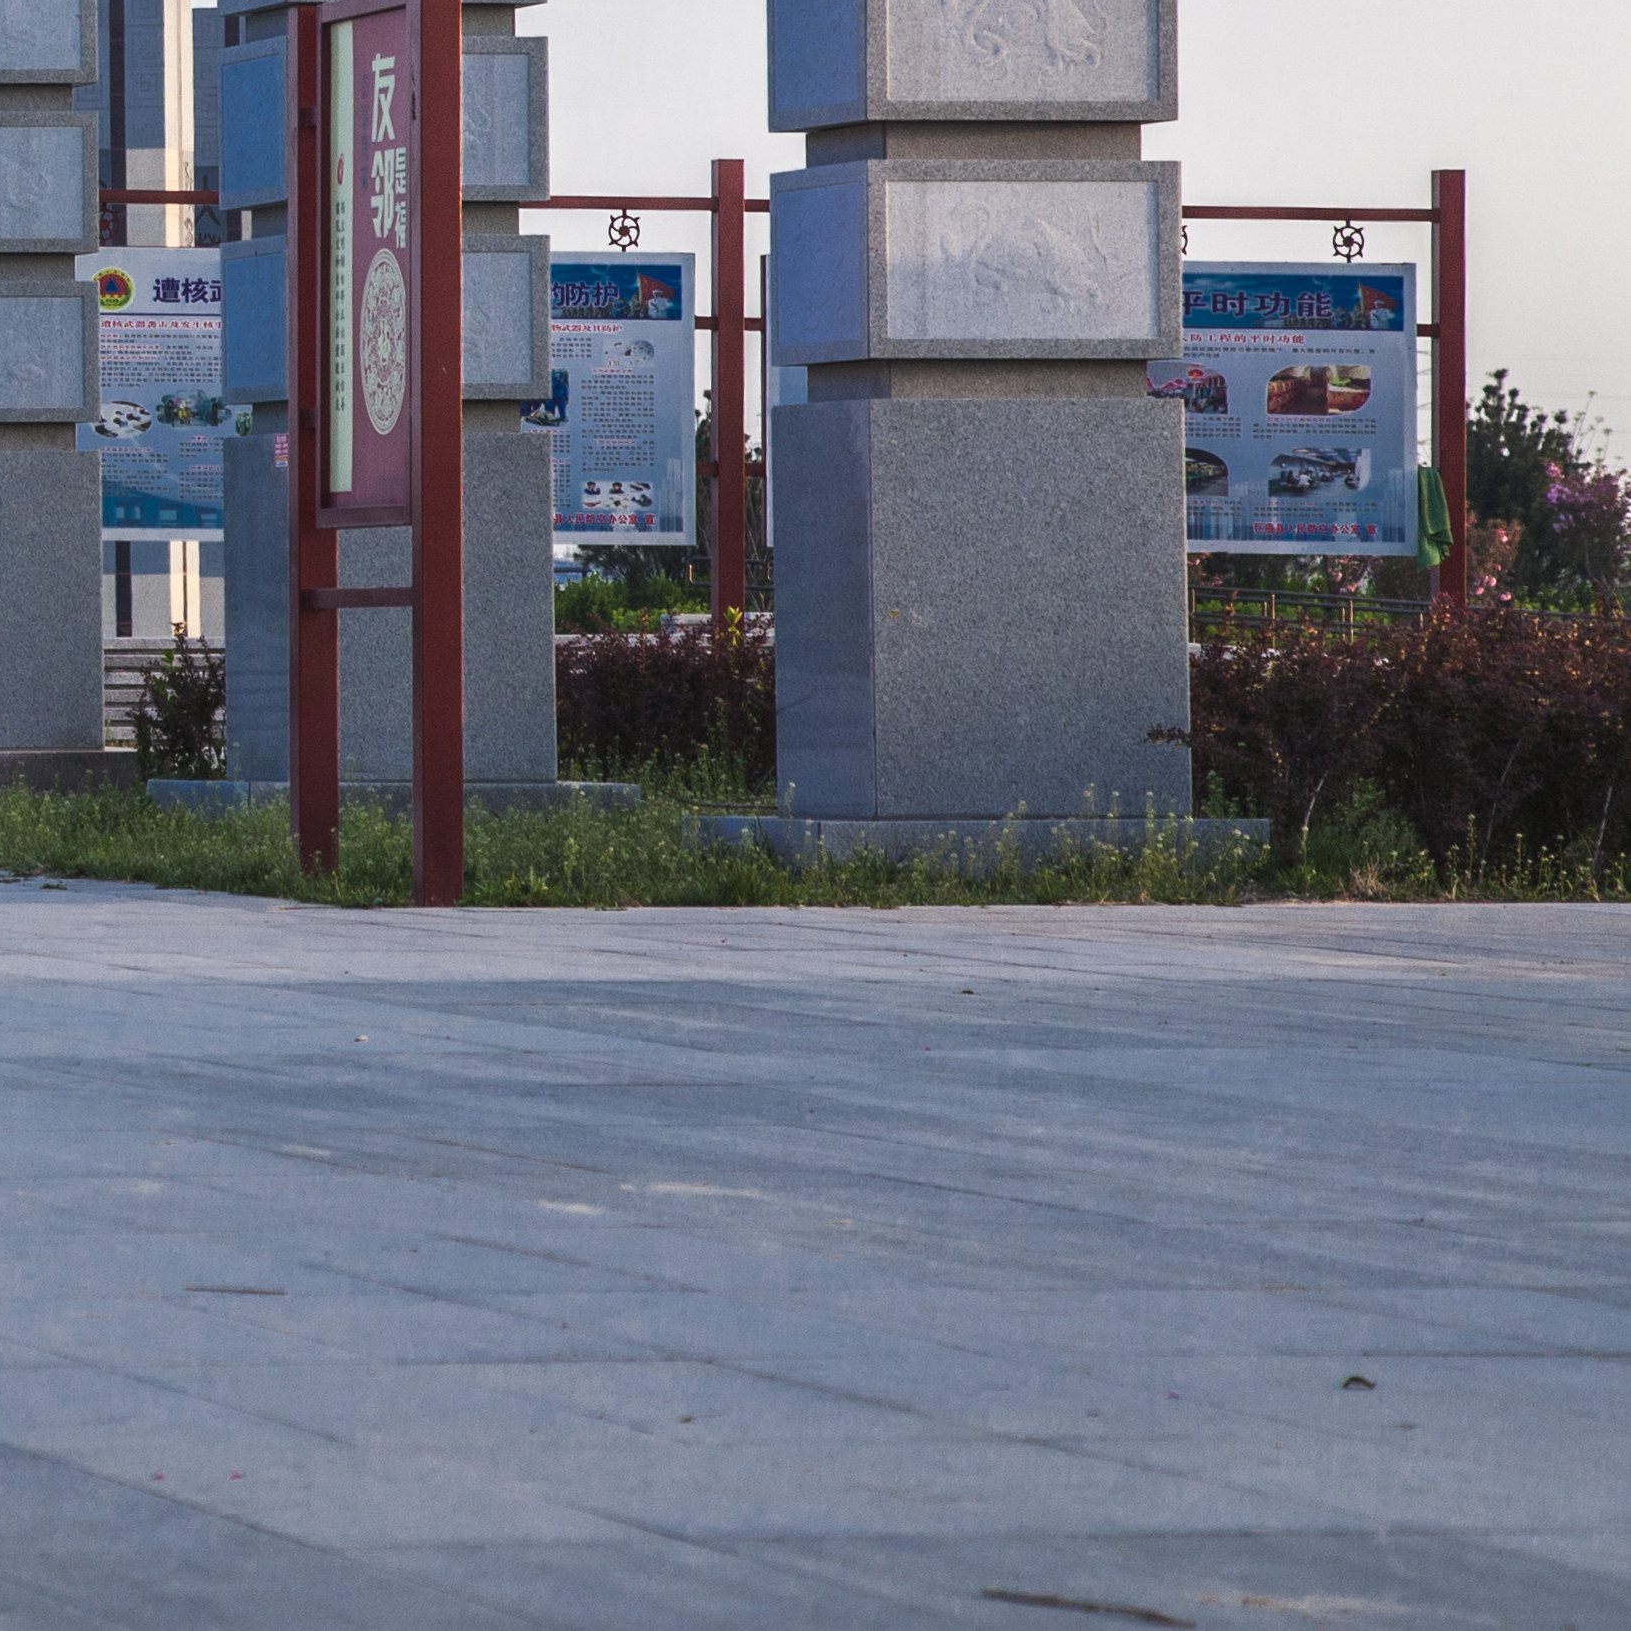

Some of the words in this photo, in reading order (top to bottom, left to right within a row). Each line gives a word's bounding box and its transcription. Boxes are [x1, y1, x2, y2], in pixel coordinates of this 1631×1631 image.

[371, 53, 396, 239] 友邻
[1182, 291, 1334, 318] 平时功能
[1182, 334, 1305, 344] 防工程的平时功能
